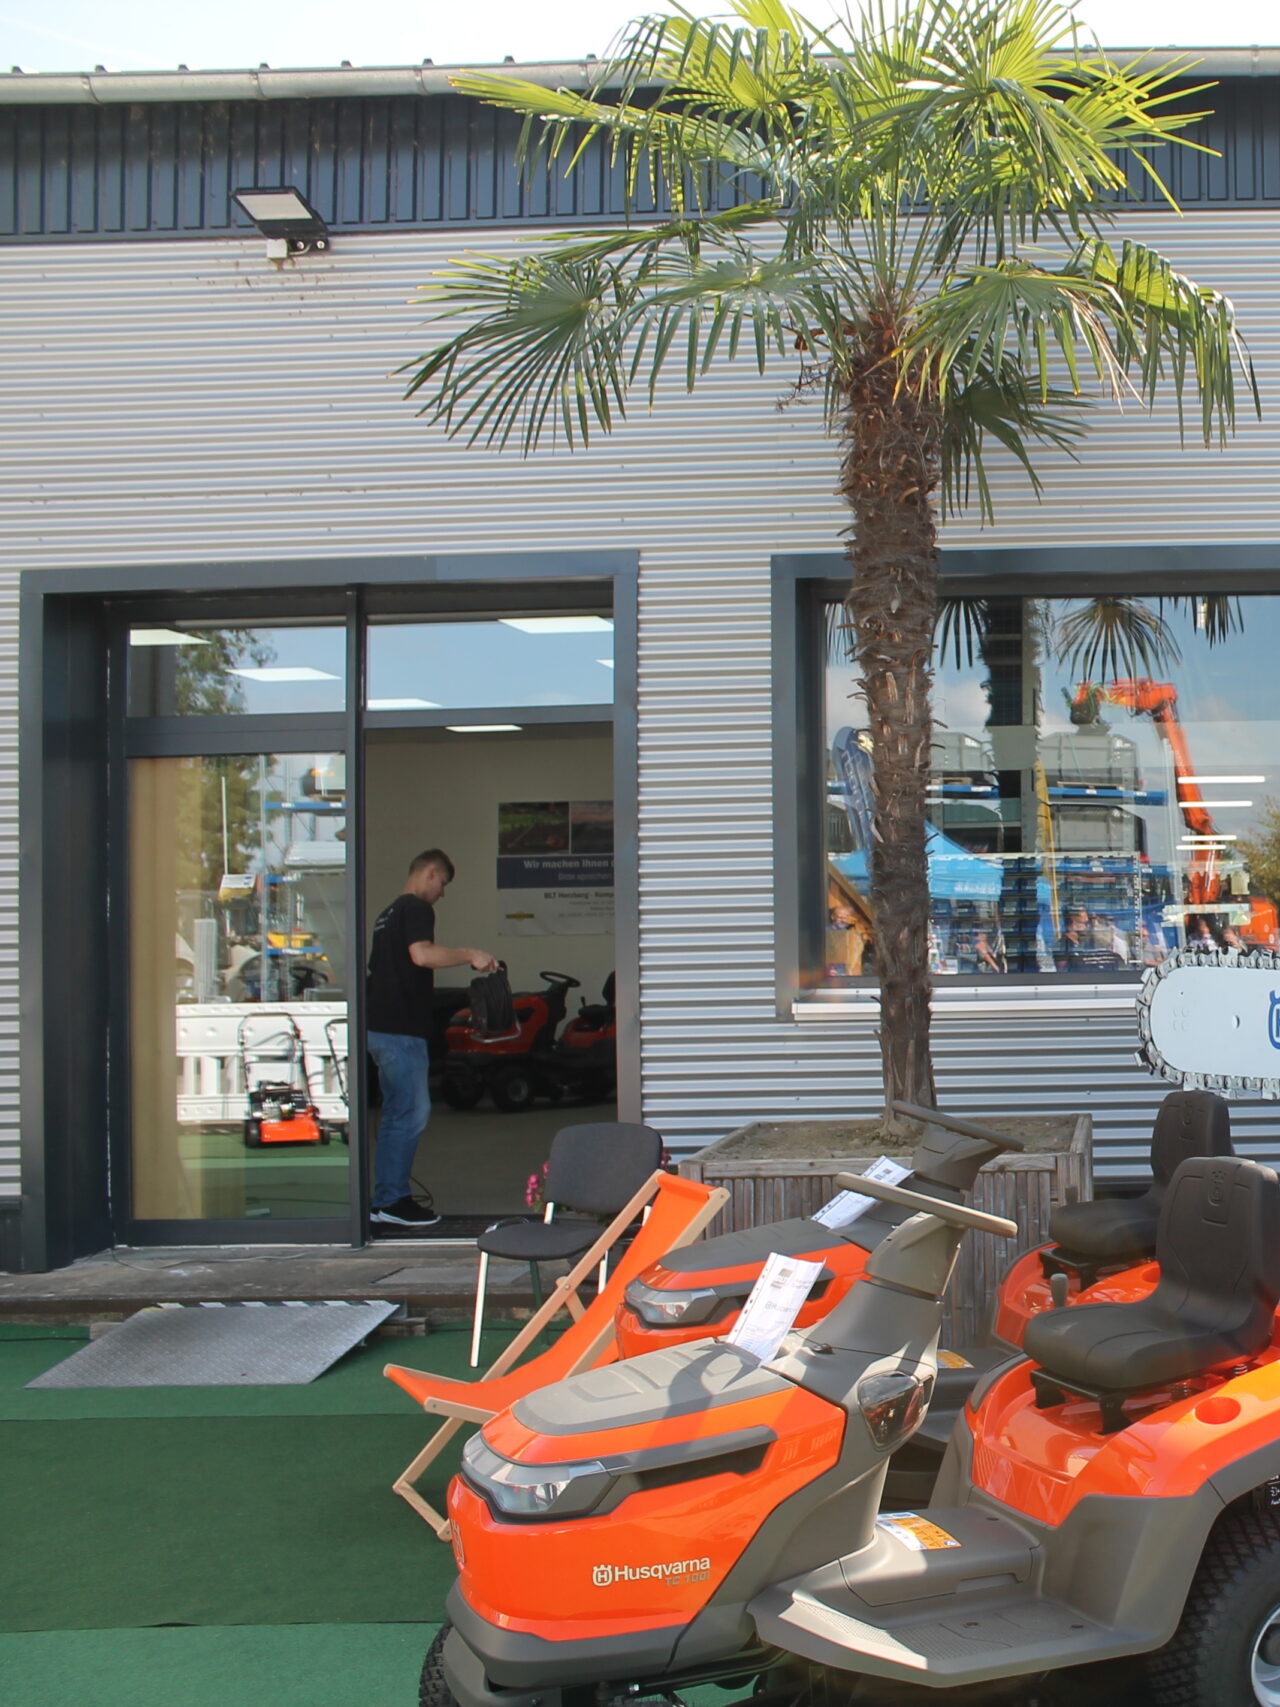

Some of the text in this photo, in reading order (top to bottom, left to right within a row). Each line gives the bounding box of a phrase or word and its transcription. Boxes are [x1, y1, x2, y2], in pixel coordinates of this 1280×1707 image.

[524, 859, 609, 870] Wir machen Ihnen
[614, 1557, 711, 1582] Husqvarna
